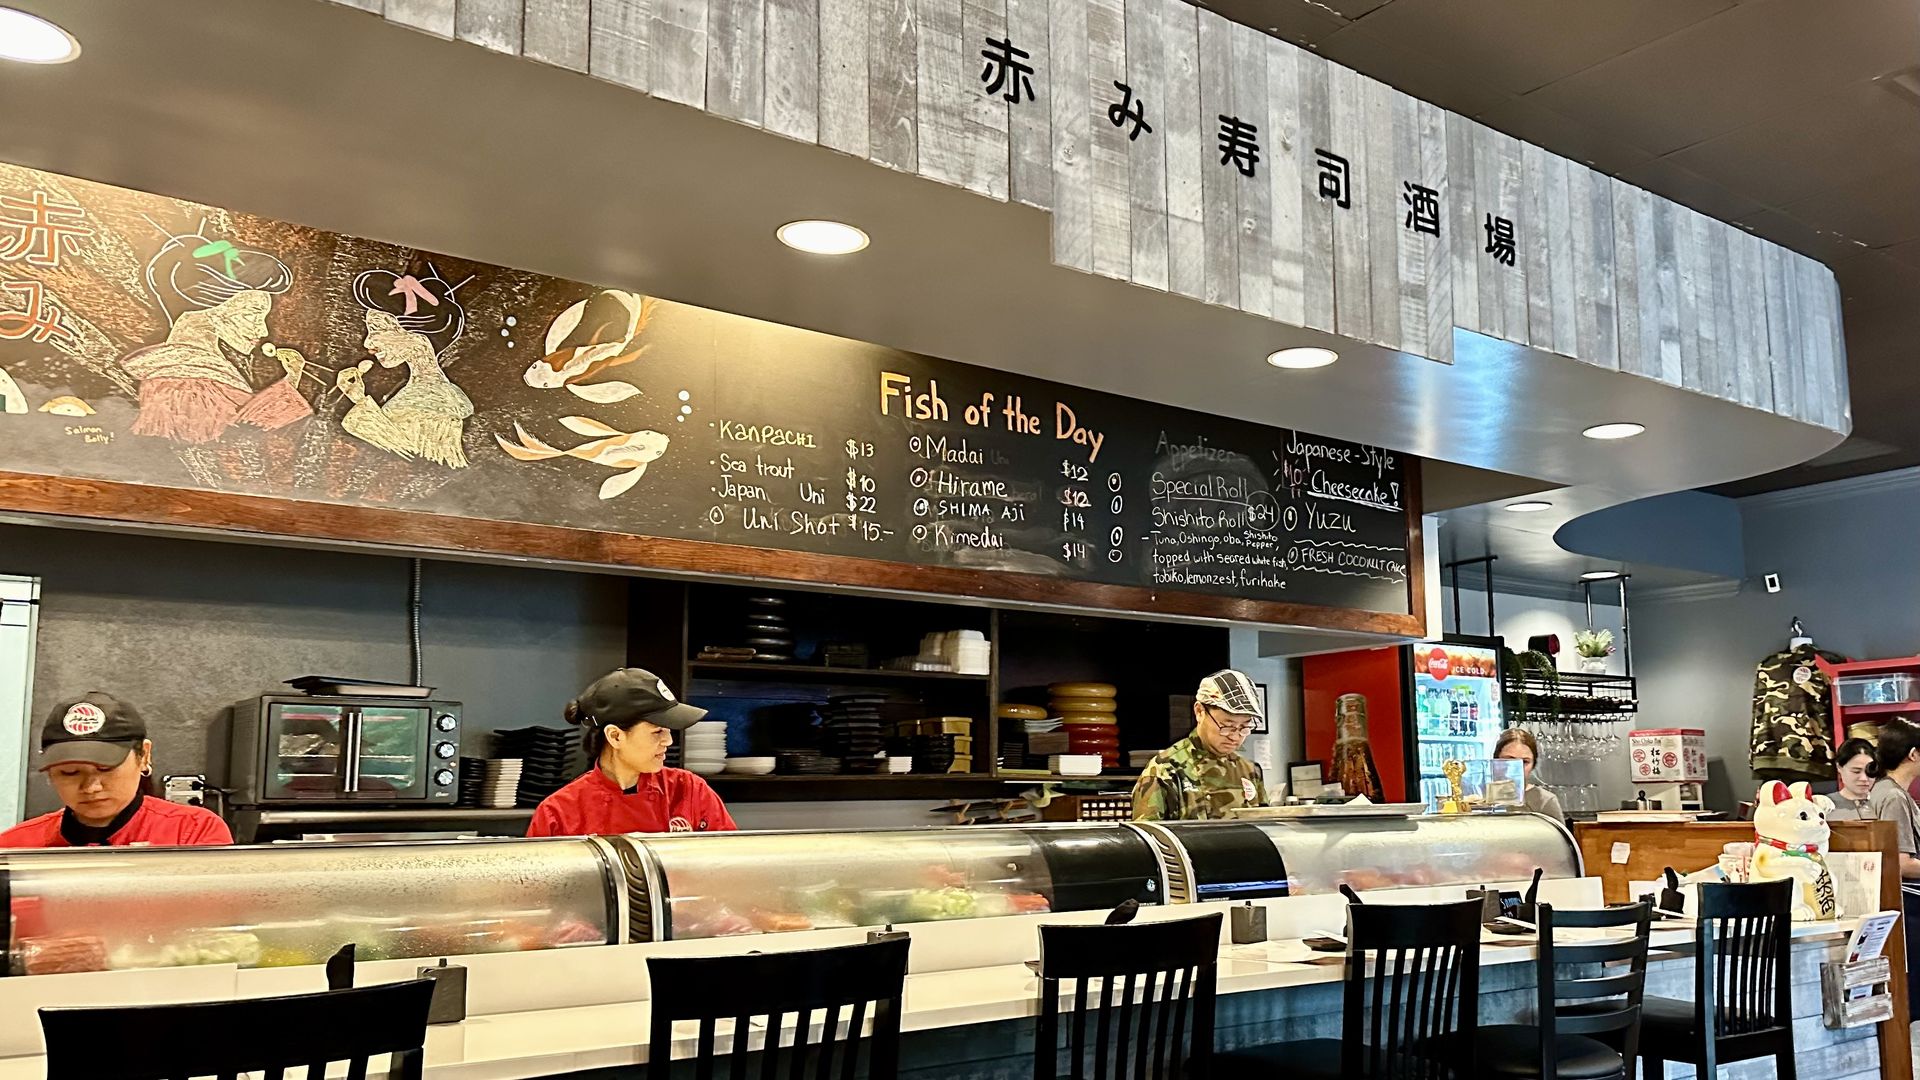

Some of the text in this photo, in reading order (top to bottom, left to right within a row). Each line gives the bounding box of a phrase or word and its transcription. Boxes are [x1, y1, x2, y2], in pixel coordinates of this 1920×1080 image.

[981, 37, 1516, 267] 赤み寿司酒場
[64, 425, 102, 435] Salmon
[880, 371, 1104, 463] Fish of the Day
[845, 439, 874, 460] $13
[926, 434, 983, 464] Madai
[1061, 459, 1089, 482] $12
[720, 453, 876, 493] Sea trout $10
[938, 470, 1008, 498] Hirame
[1152, 472, 1248, 502] Special Roll
[718, 475, 876, 514] Japan Uni $22
[743, 507, 778, 531] Uni
[790, 511, 840, 535] Shot
[938, 500, 990, 516] SHIMA
[1063, 507, 1085, 532] $14
[1152, 504, 1274, 528] Shishito Roll $24
[1305, 502, 1357, 532] Yuzu
[935, 524, 1085, 561] Kimedai $14
[1153, 548, 1190, 567] topped
[1194, 550, 1215, 563] with
[1217, 553, 1250, 565] seared
[1301, 547, 1334, 563] FRESH
[1338, 551, 1385, 570] COCONUT
